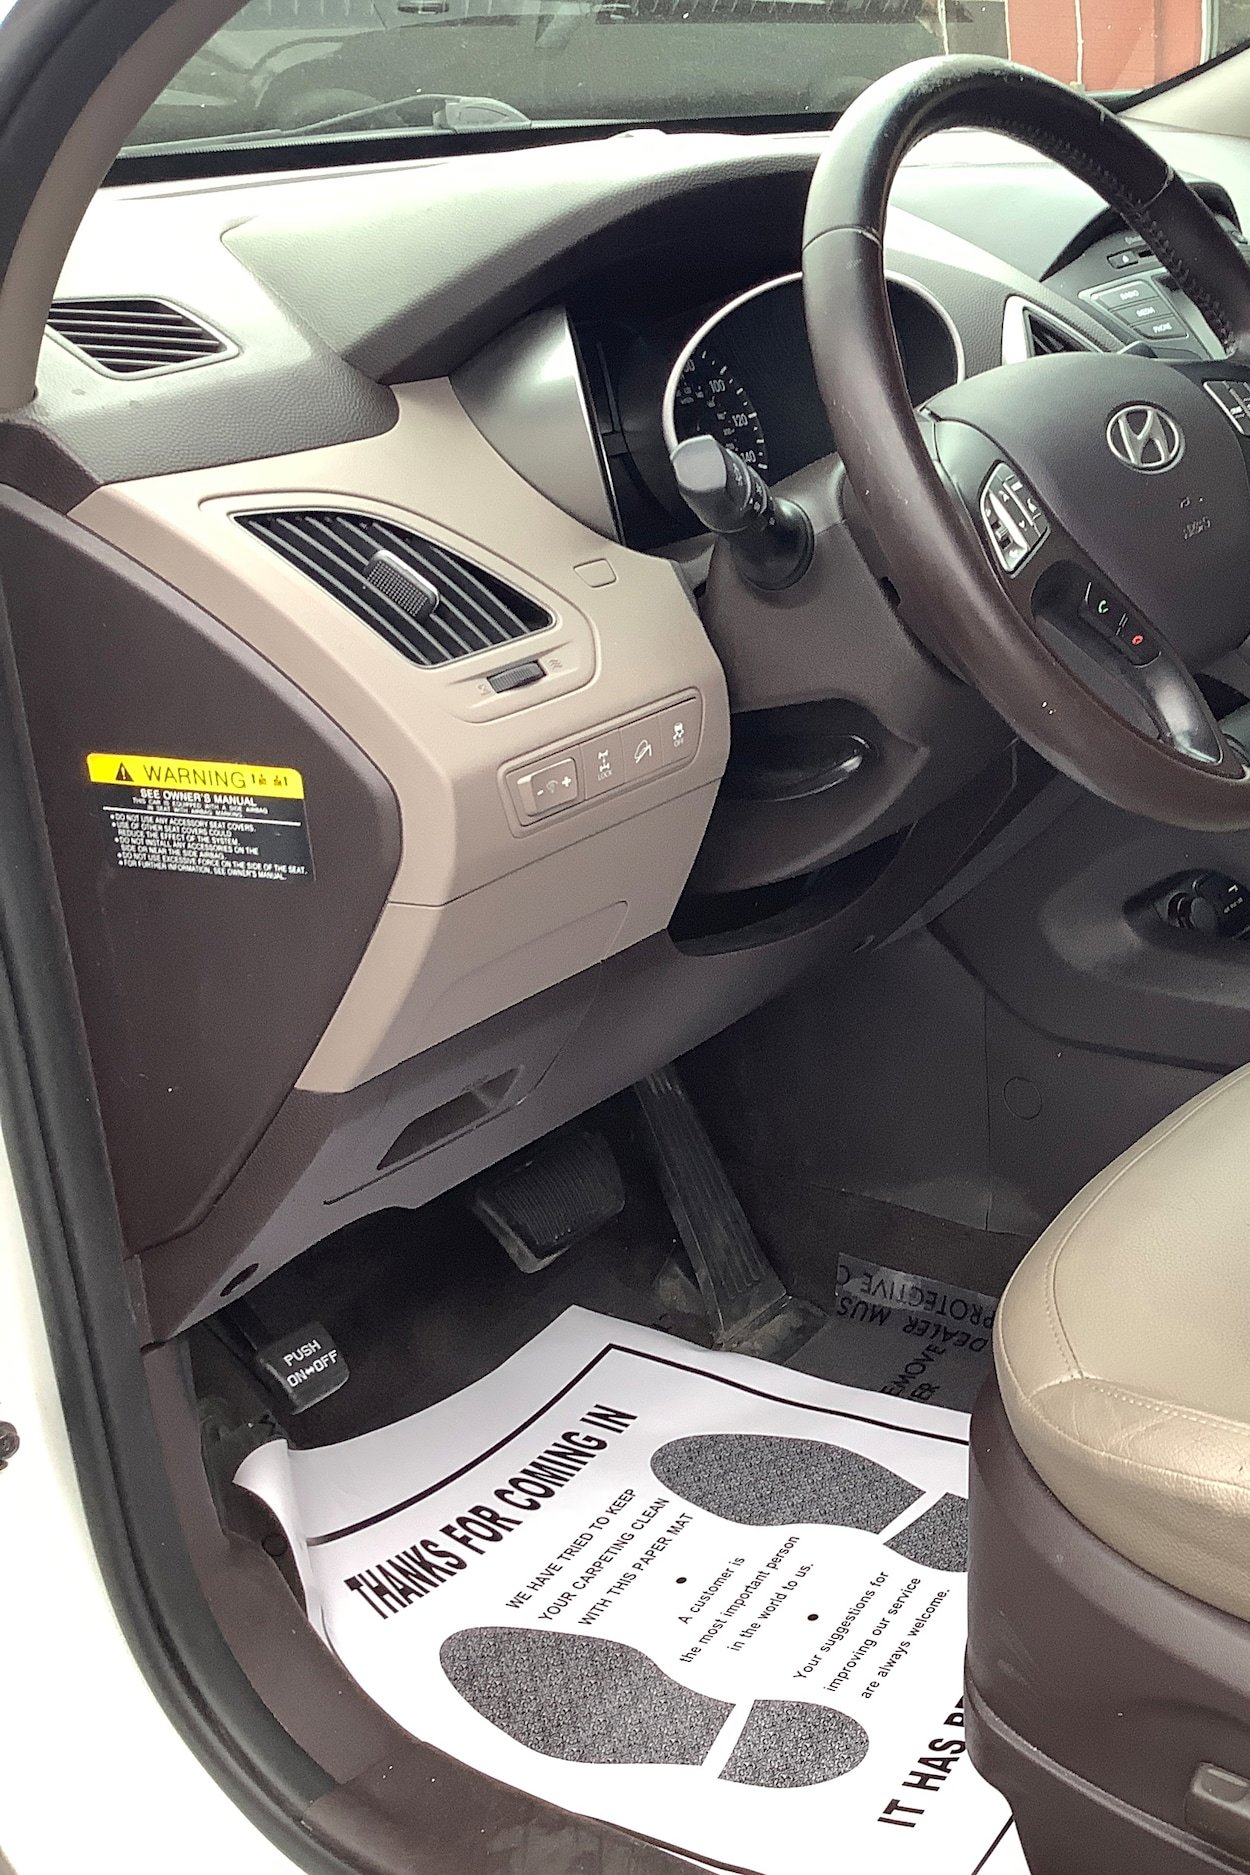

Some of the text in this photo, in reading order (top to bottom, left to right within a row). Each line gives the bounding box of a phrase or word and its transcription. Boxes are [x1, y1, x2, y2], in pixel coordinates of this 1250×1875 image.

[708, 379, 726, 393] 100
[732, 413, 748, 427] 120
[140, 788, 257, 807] SEE OWNER'S MANUAL
[143, 764, 247, 789] WARNING
[860, 1272, 994, 1330] PROTECTIVE
[902, 1315, 989, 1352] DEALER
[283, 1339, 322, 1367] PUSH
[343, 1403, 638, 1620] THANKS FOR COMING IN
[505, 1488, 637, 1609] WE HAVE TRIED TO KEEP
[538, 1497, 670, 1621] YOUR CARPETING CLEAN
[578, 1512, 694, 1626] WITH THIS PAPER MAT
[678, 1556, 745, 1624] A customer is
[679, 1536, 800, 1663] the most important person
[727, 1563, 814, 1652] in the world to us.
[792, 1571, 889, 1680] Your suggestions for
[823, 1577, 921, 1692] improving our service
[861, 1589, 951, 1699] are always welcome.
[877, 1738, 966, 1828] IT HAS
